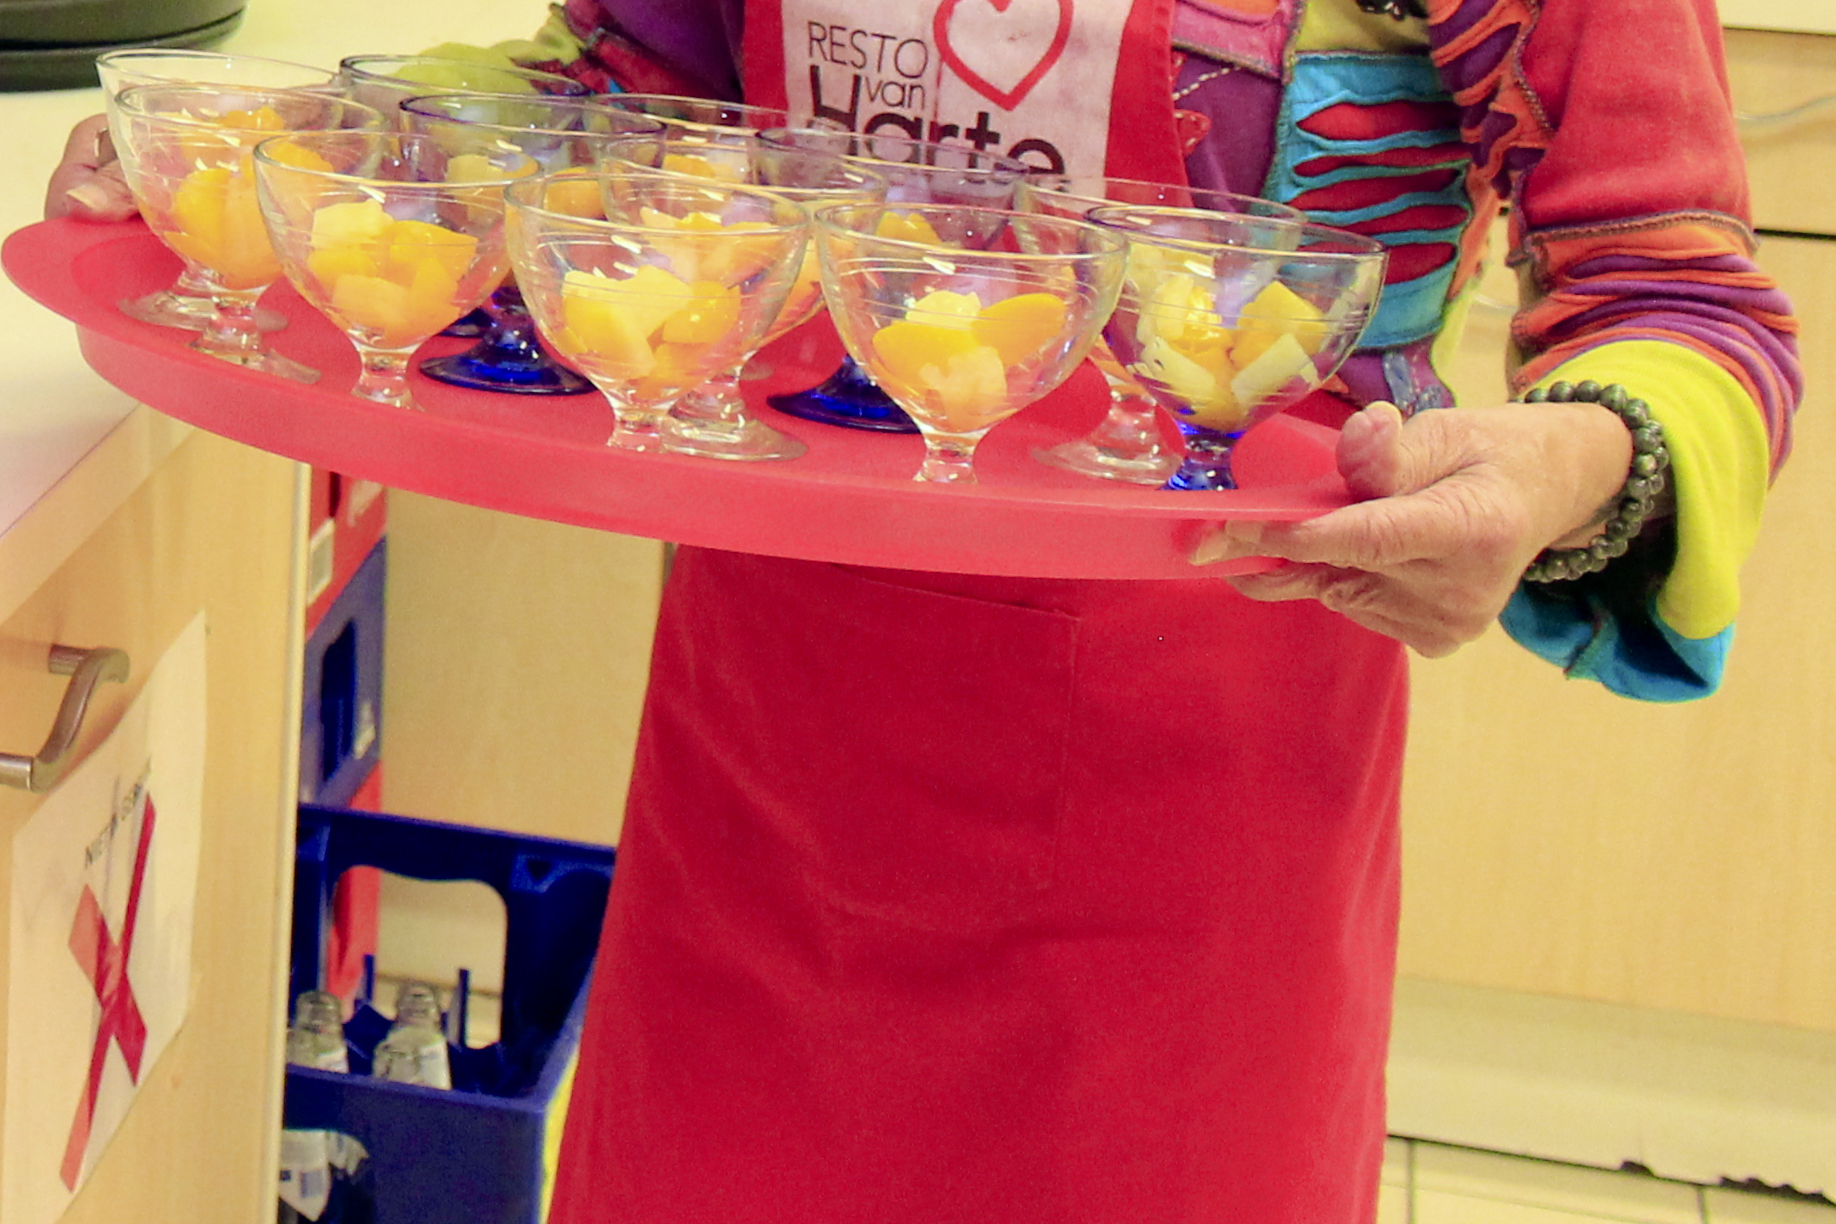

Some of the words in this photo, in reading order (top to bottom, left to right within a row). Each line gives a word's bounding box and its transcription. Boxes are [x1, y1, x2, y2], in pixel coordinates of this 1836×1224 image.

[807, 21, 929, 80] RESTO
[863, 75, 926, 110] van
[807, 64, 1070, 188] Harte
